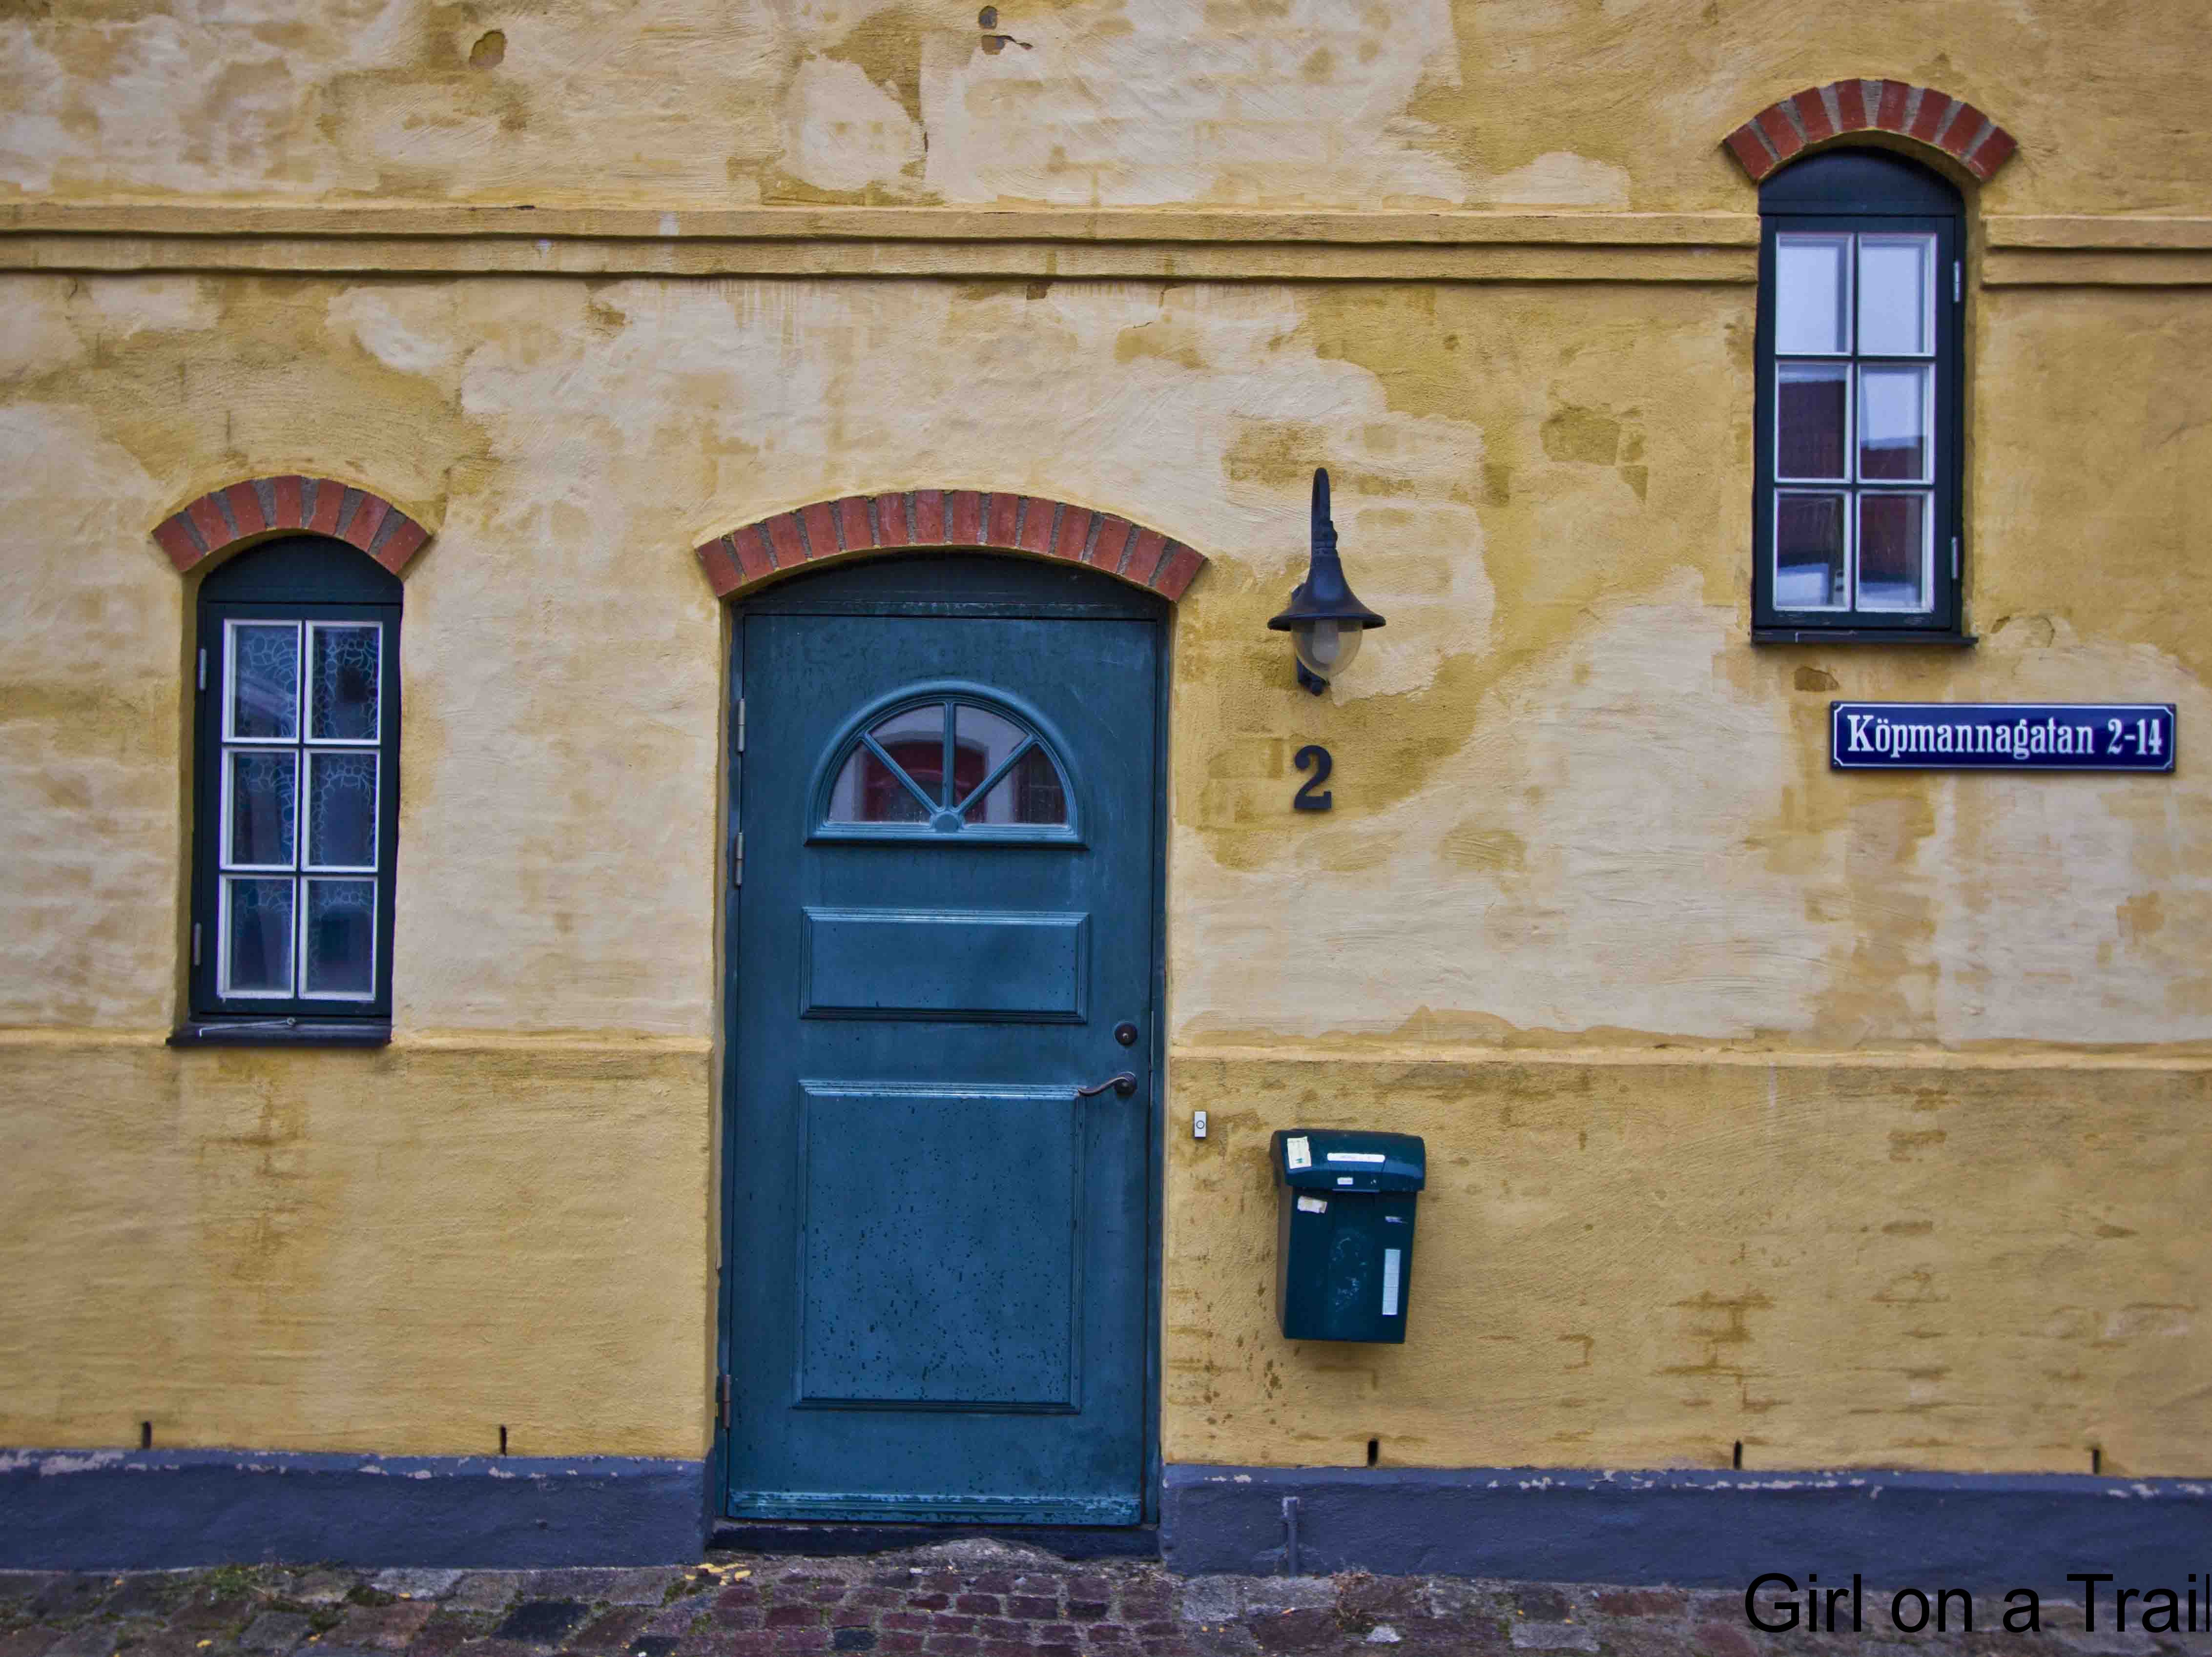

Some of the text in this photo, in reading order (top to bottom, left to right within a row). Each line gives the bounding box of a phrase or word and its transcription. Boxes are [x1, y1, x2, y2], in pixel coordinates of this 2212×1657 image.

[1847, 714, 2162, 758] Köpmannagatan 2-14
[1294, 745, 1332, 809] 2
